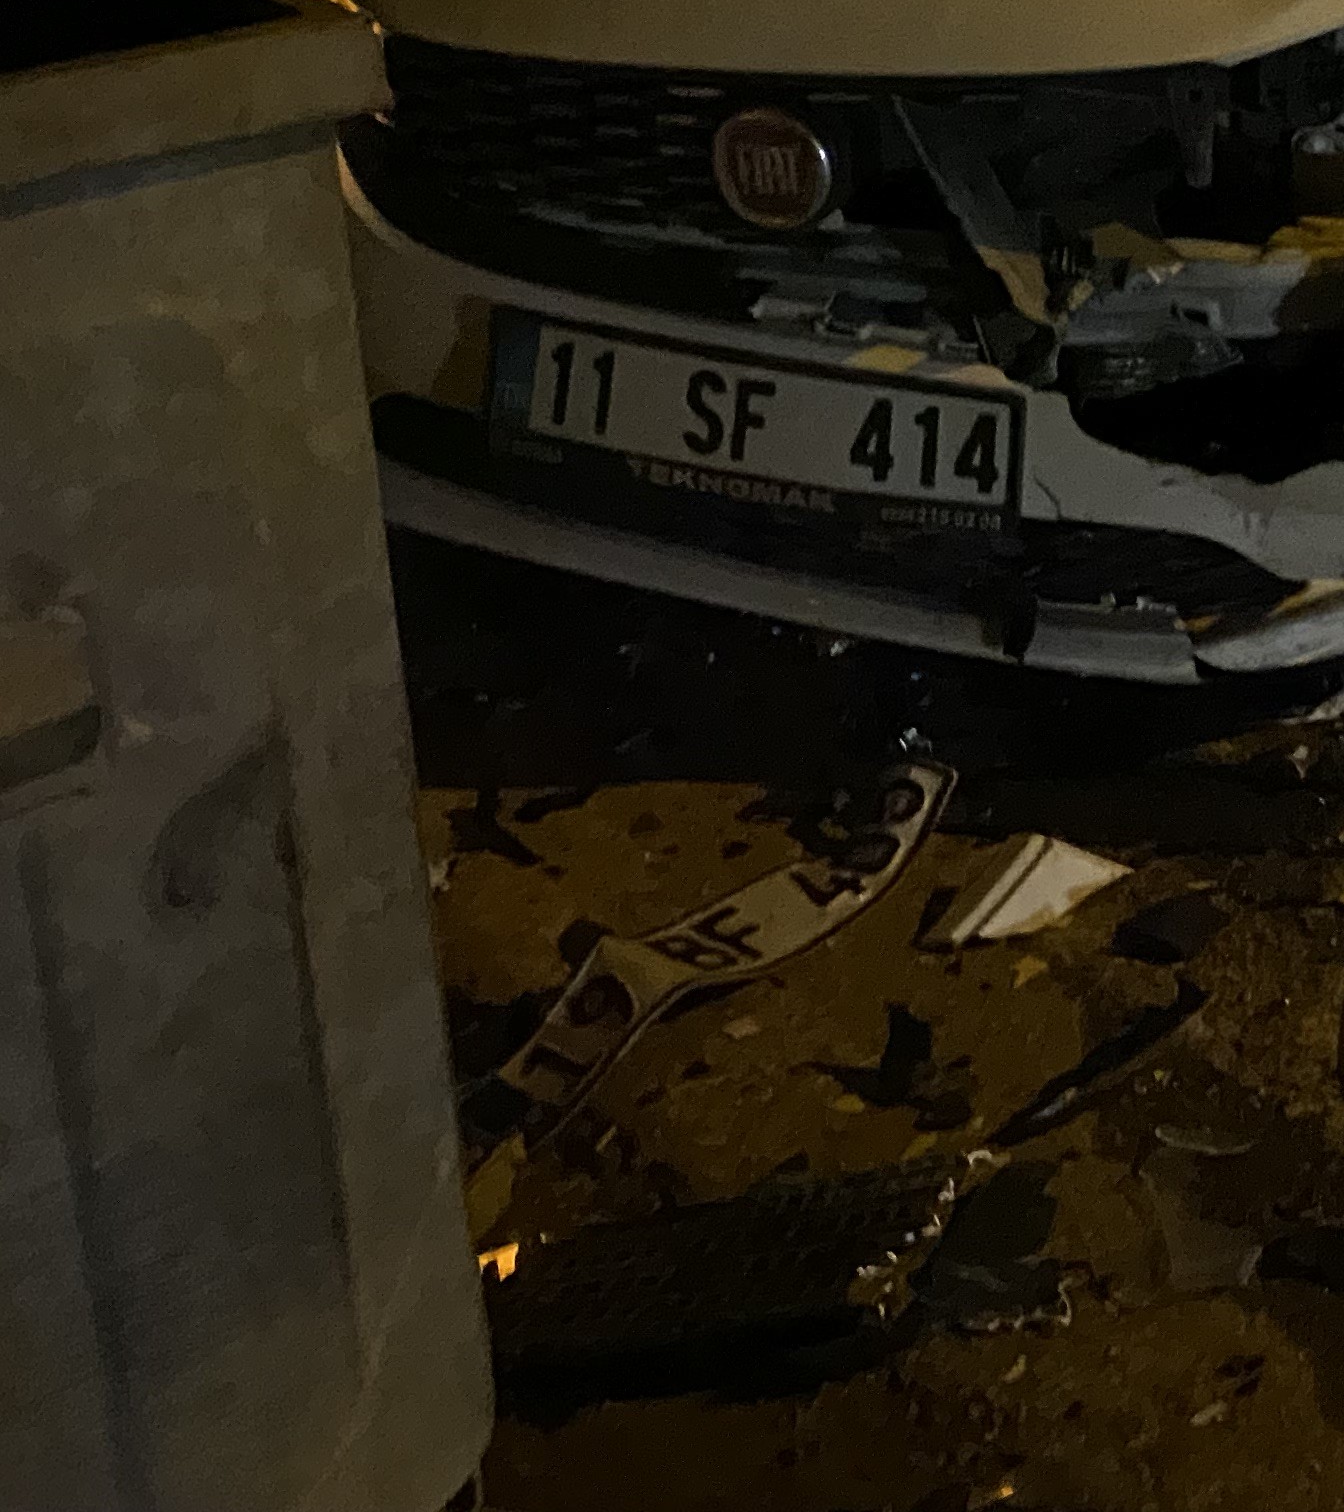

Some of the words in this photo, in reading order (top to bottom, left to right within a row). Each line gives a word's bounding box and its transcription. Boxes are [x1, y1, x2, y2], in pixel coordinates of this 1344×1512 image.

[551, 342, 614, 435] 11
[682, 369, 776, 462] SF
[849, 398, 999, 494] 414
[644, 906, 764, 972] BF
